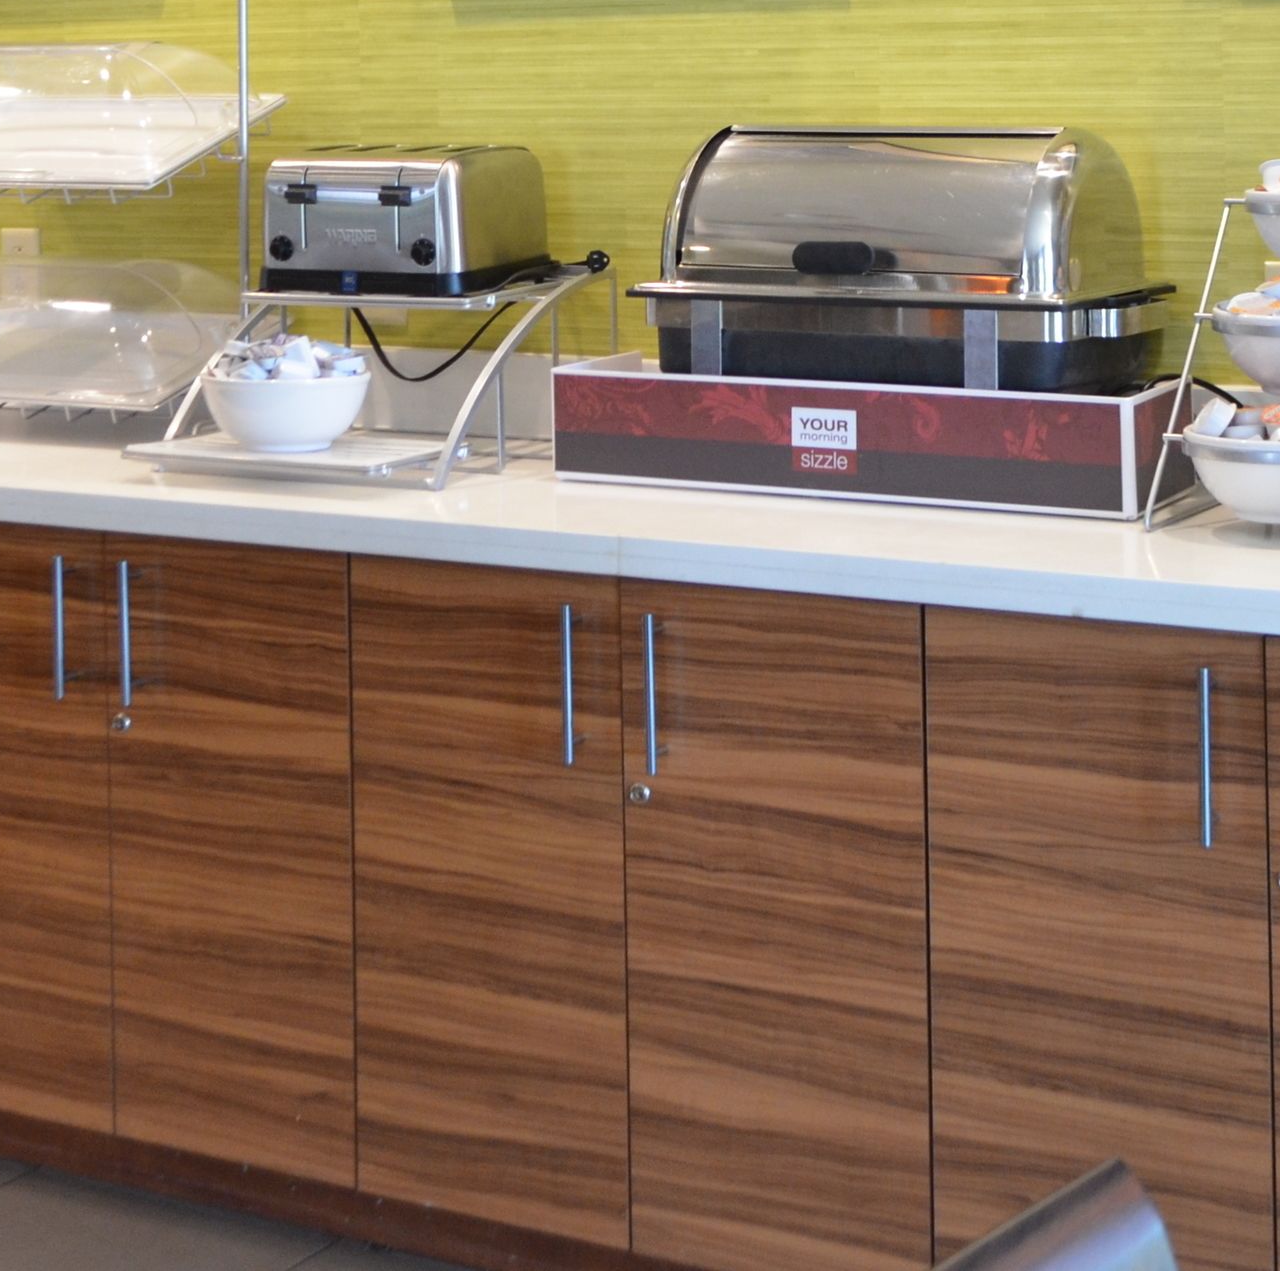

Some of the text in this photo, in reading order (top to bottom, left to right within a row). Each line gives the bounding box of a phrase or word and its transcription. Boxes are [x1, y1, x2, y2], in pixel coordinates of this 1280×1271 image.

[799, 417, 848, 433] YOUR
[800, 432, 848, 445] morning
[800, 449, 848, 470] sizzle
